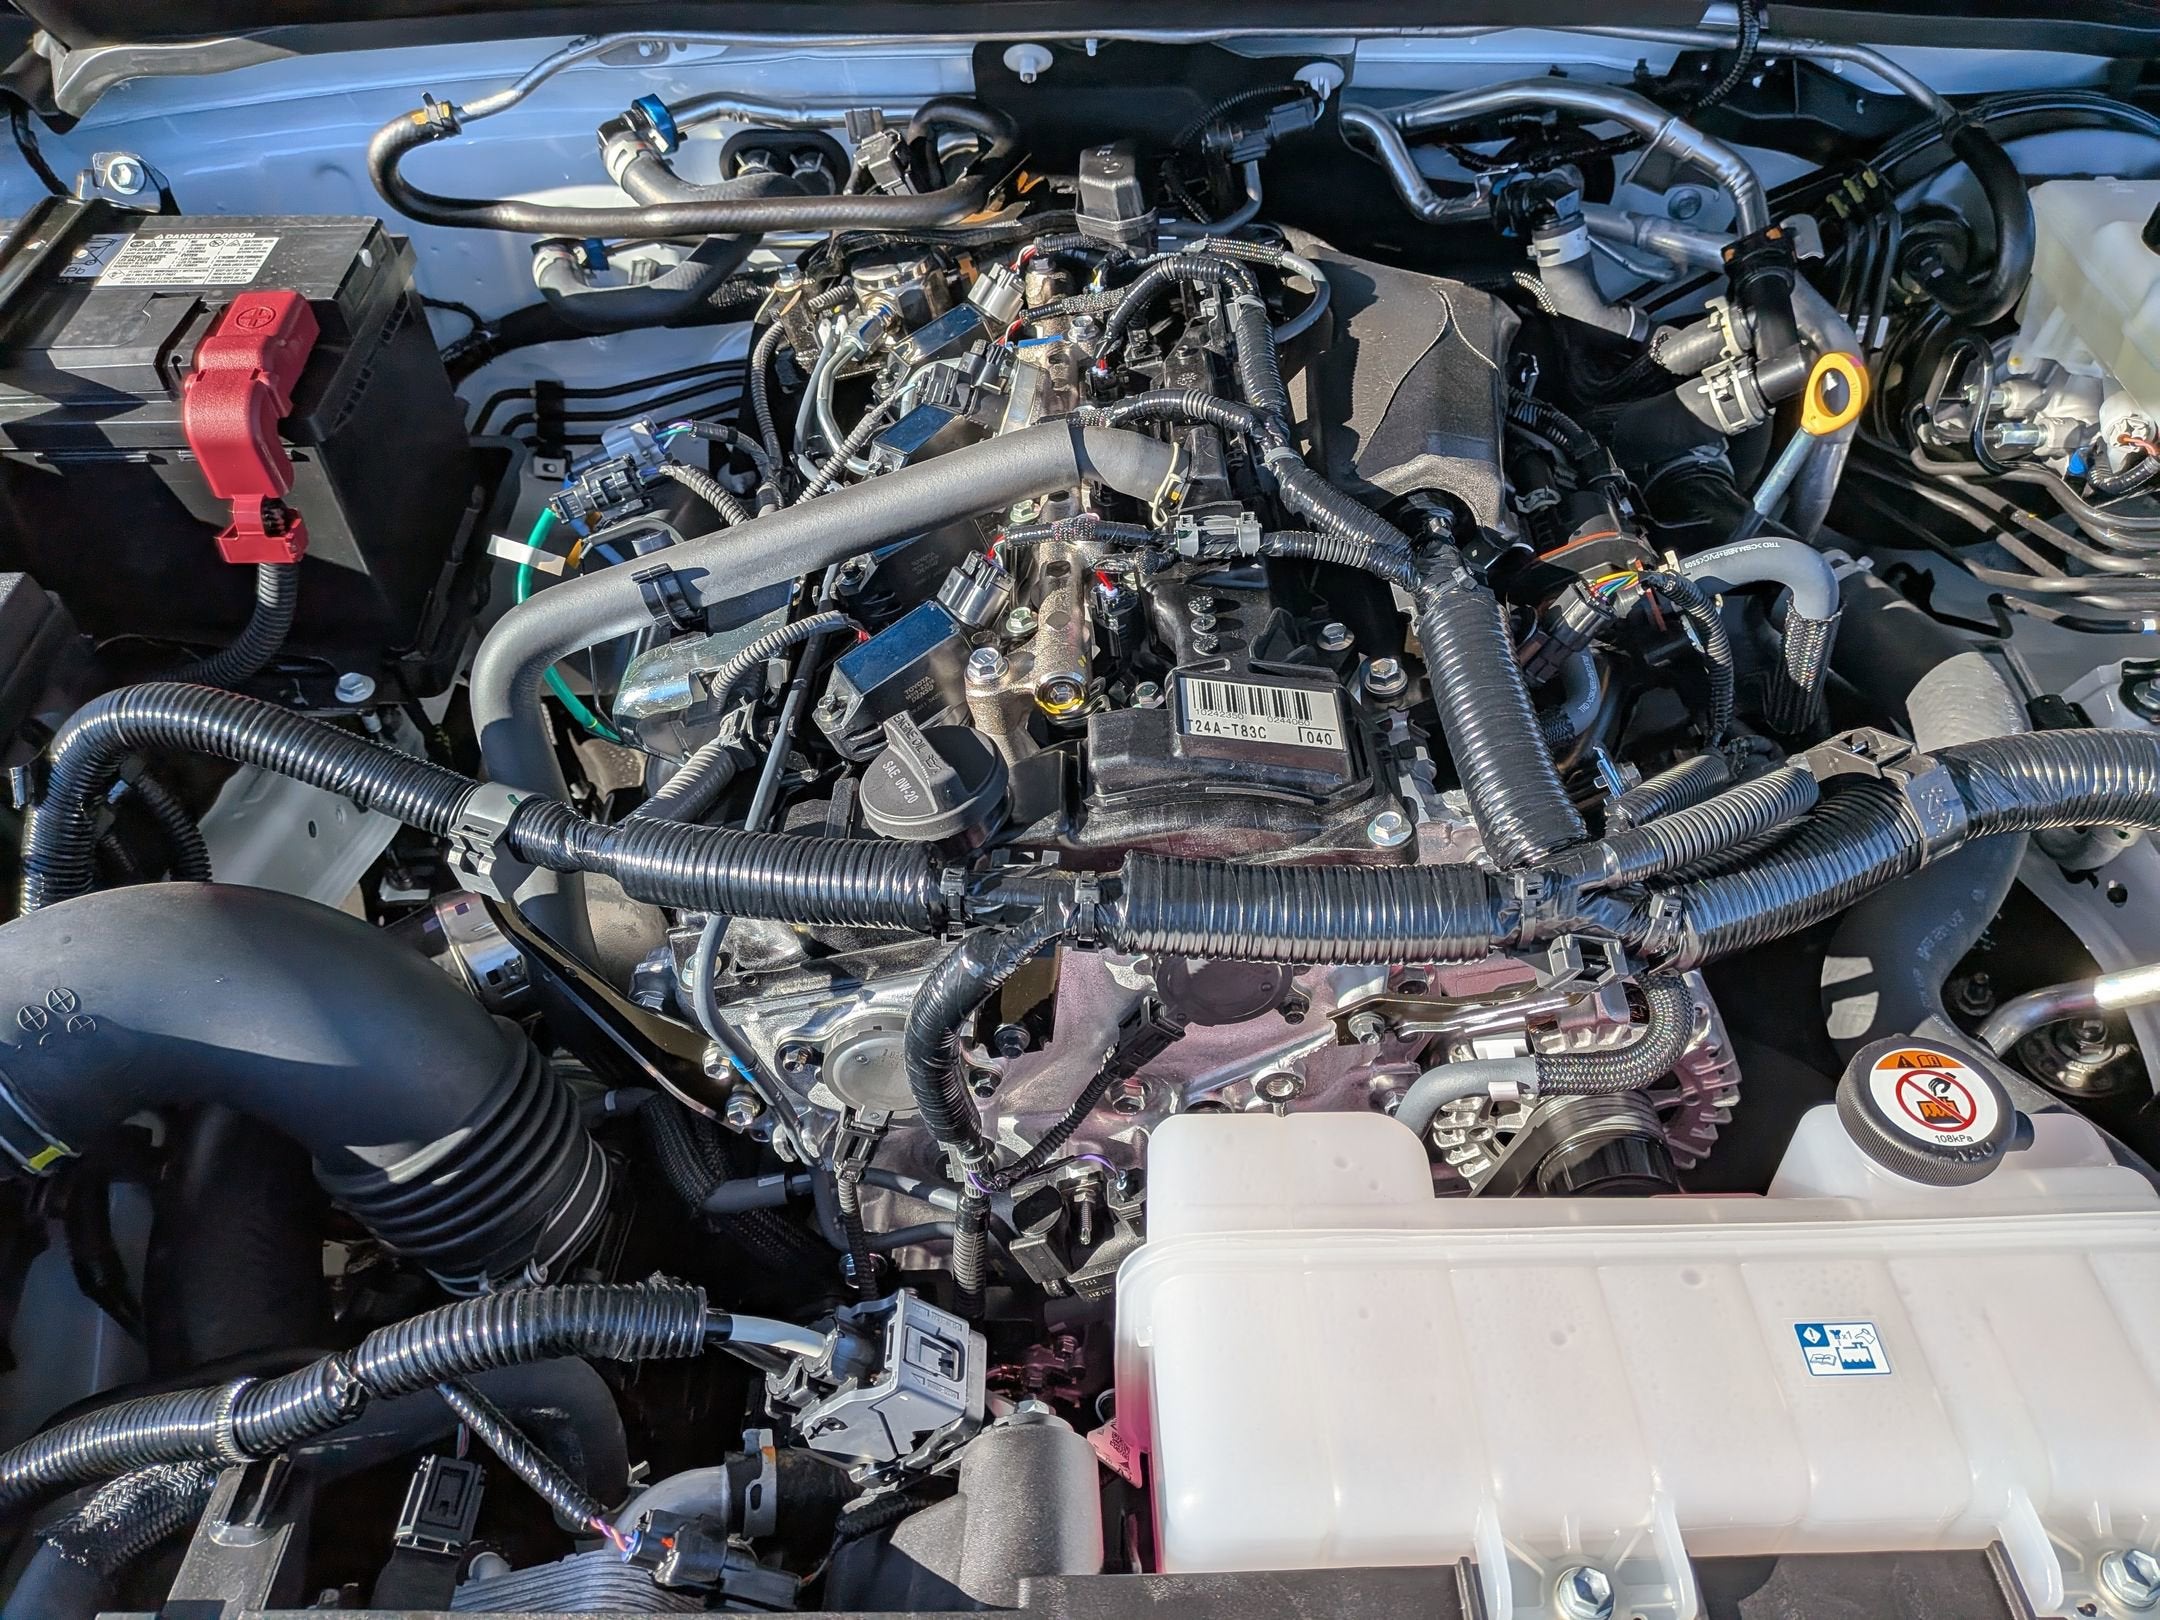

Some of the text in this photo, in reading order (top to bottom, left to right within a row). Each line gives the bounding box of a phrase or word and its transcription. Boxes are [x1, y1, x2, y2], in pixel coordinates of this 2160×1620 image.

[64, 267, 85, 275] Pb
[904, 676, 931, 695] TOYOTA
[911, 684, 934, 703] DENSO
[1196, 708, 1245, 720] 10242350
[893, 713, 928, 754] ENGINE OIL
[1186, 719, 1333, 746] T24A-T83C 040
[882, 760, 901, 779] SAE
[1934, 1134, 1974, 1143] 108kPa
